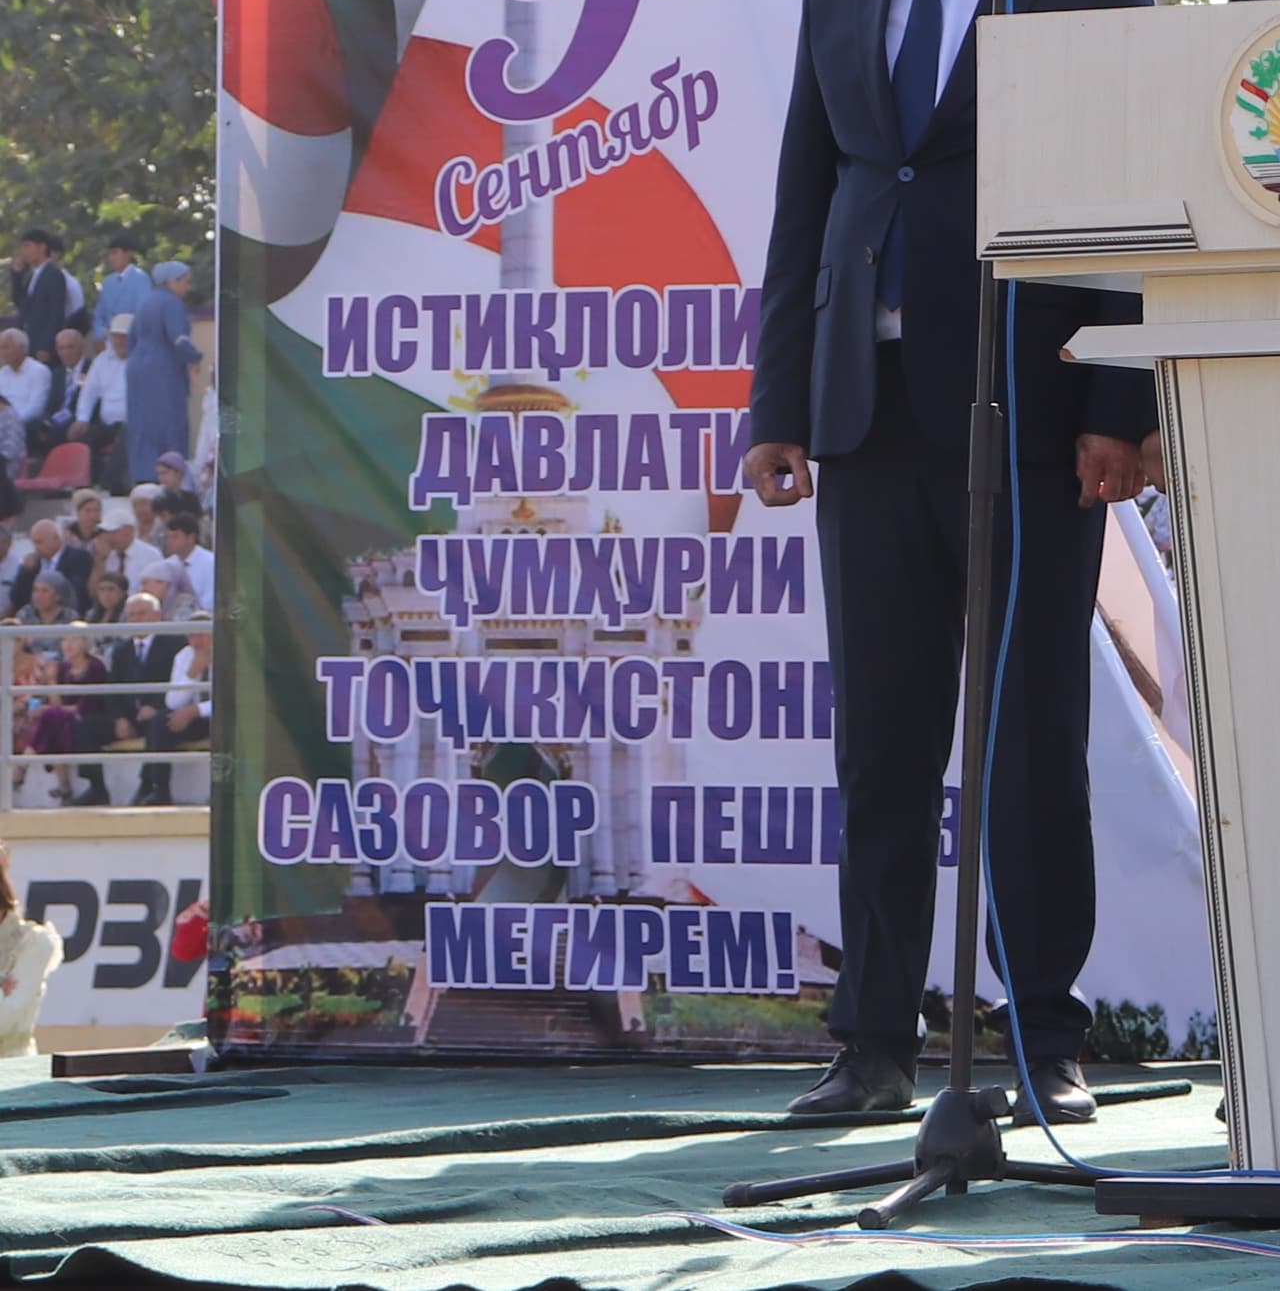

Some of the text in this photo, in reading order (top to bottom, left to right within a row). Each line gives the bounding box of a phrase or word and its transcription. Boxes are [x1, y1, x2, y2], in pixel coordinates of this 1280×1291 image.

[437, 57, 719, 236] Сентябр
[327, 287, 763, 381] ИСТИҚЛОЛИ
[411, 412, 787, 506] ДАВЛАТИ
[319, 660, 835, 746] ТОҶИКИСТОН
[261, 781, 595, 864] САЗОВОР
[427, 905, 795, 989] МЕГИРЕМ!
